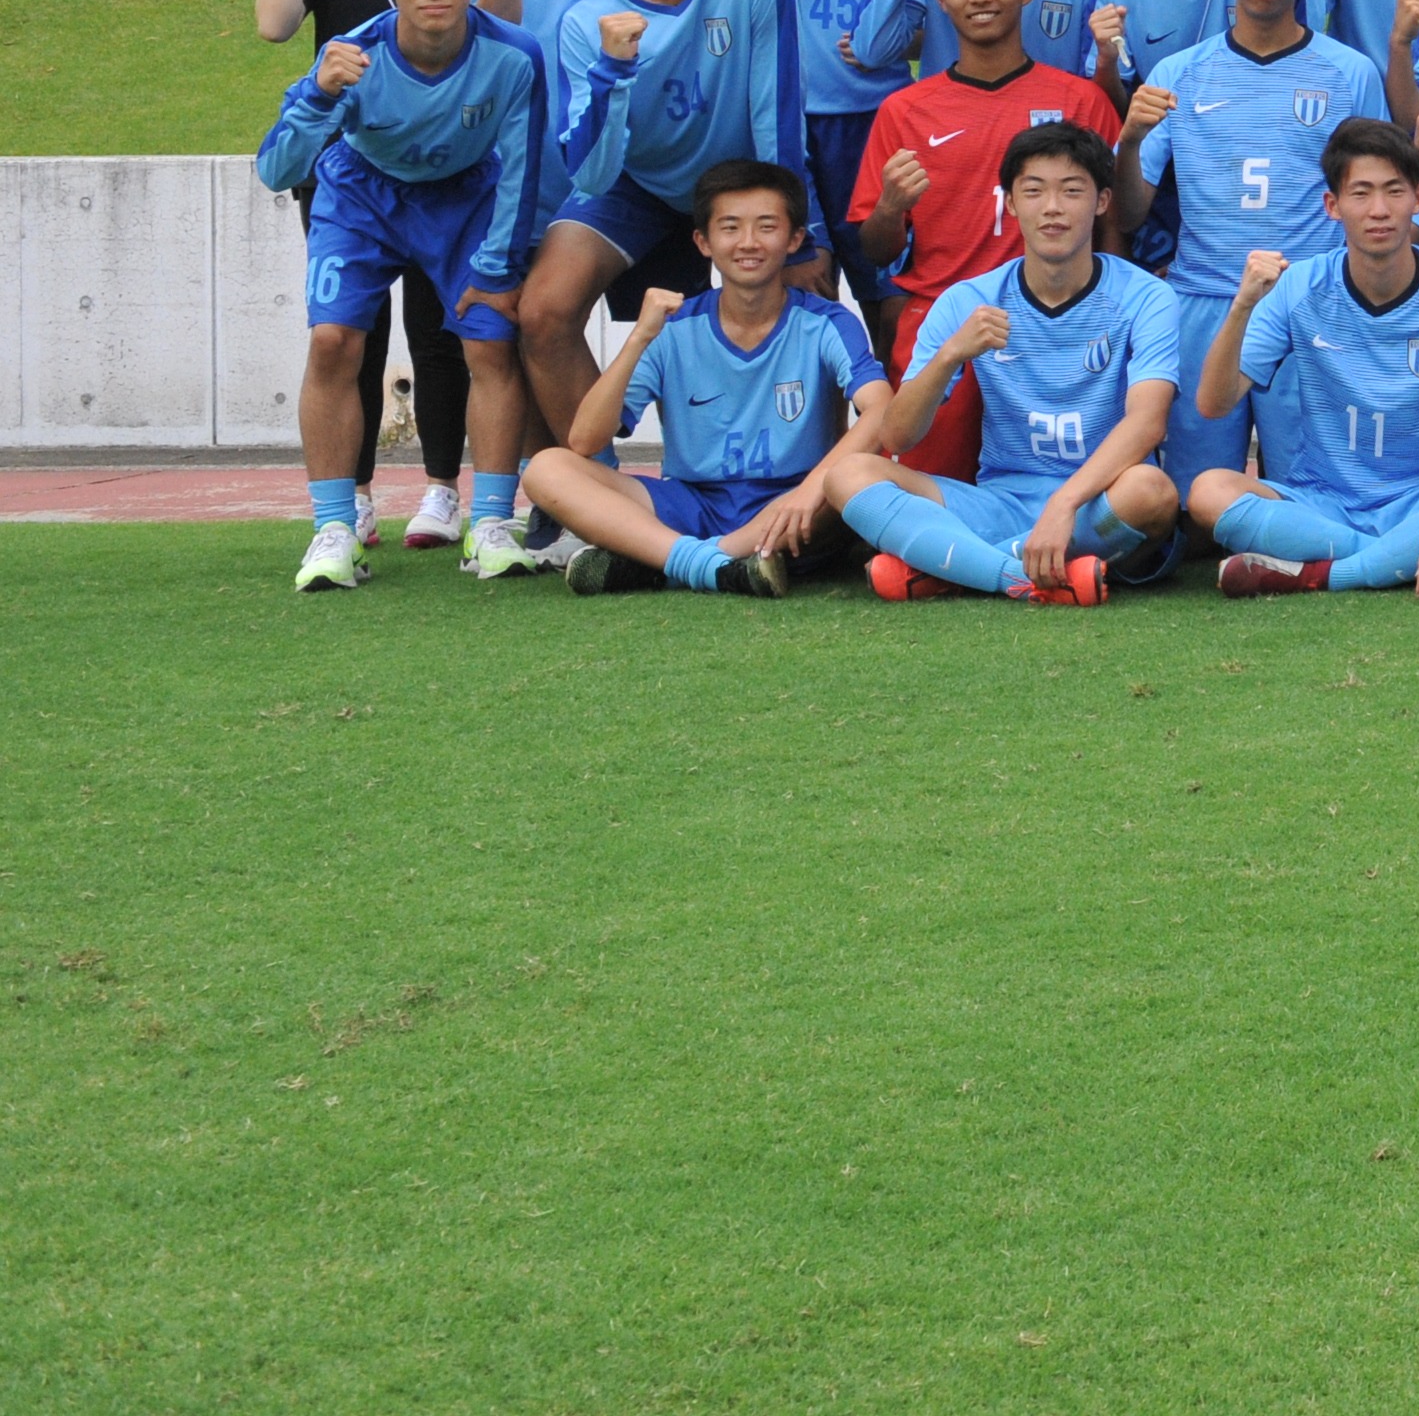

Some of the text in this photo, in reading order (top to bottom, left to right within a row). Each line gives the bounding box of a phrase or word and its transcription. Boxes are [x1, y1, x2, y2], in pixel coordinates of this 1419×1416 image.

[664, 70, 707, 122] 34
[1240, 158, 1271, 210] 5
[721, 428, 776, 480] 54
[1027, 411, 1085, 460] 20
[1345, 405, 1385, 458] 11
